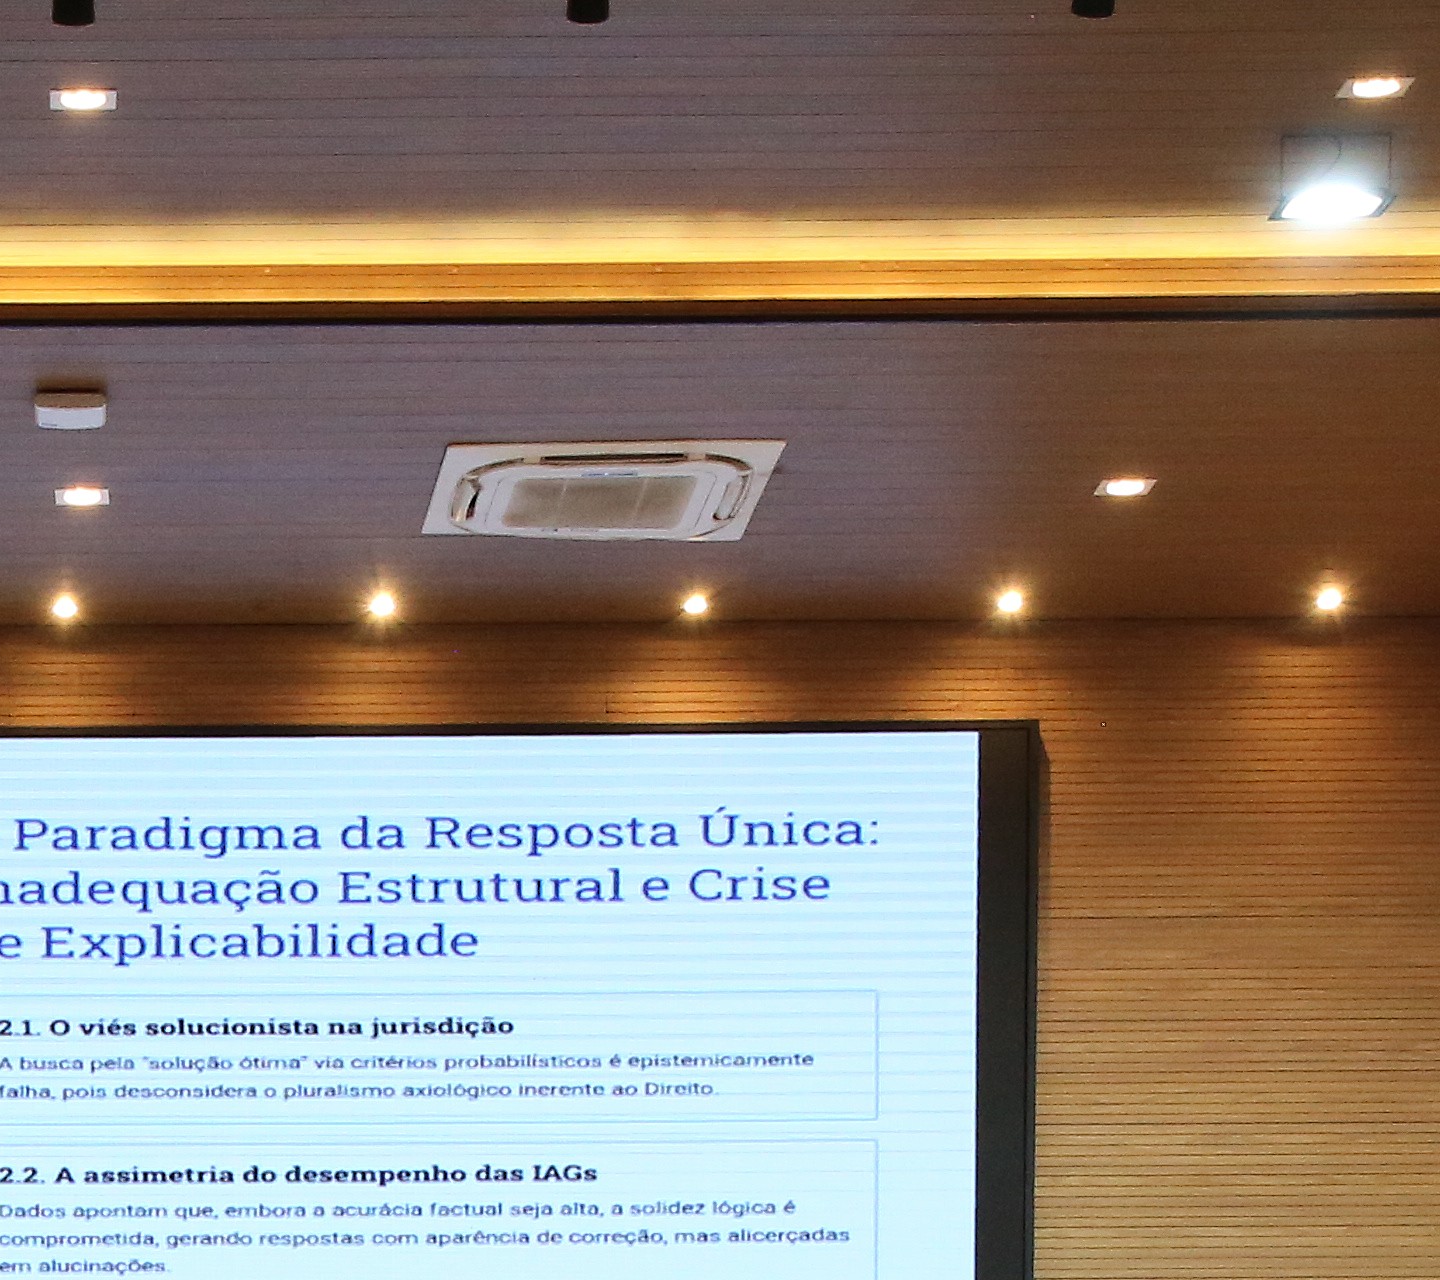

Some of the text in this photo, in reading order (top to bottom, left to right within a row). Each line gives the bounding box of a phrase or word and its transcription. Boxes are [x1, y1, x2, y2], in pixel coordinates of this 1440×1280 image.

[15, 816, 320, 859] Paradigma
[341, 815, 404, 850] da
[426, 817, 678, 857] Resposta
[700, 806, 877, 847] Única:
[339, 868, 623, 904] Estrutural
[643, 877, 669, 902] e
[689, 866, 829, 901] Crise
[42, 922, 477, 967] Explicabilidade
[50, 1019, 71, 1037] O
[81, 1016, 138, 1037] viés
[146, 1018, 318, 1036] solucionista
[329, 1022, 362, 1034] na
[372, 1017, 513, 1039] jurisdição
[0, 1163, 597, 1187] 2.2. A assimetria do desempenho das IAGs
